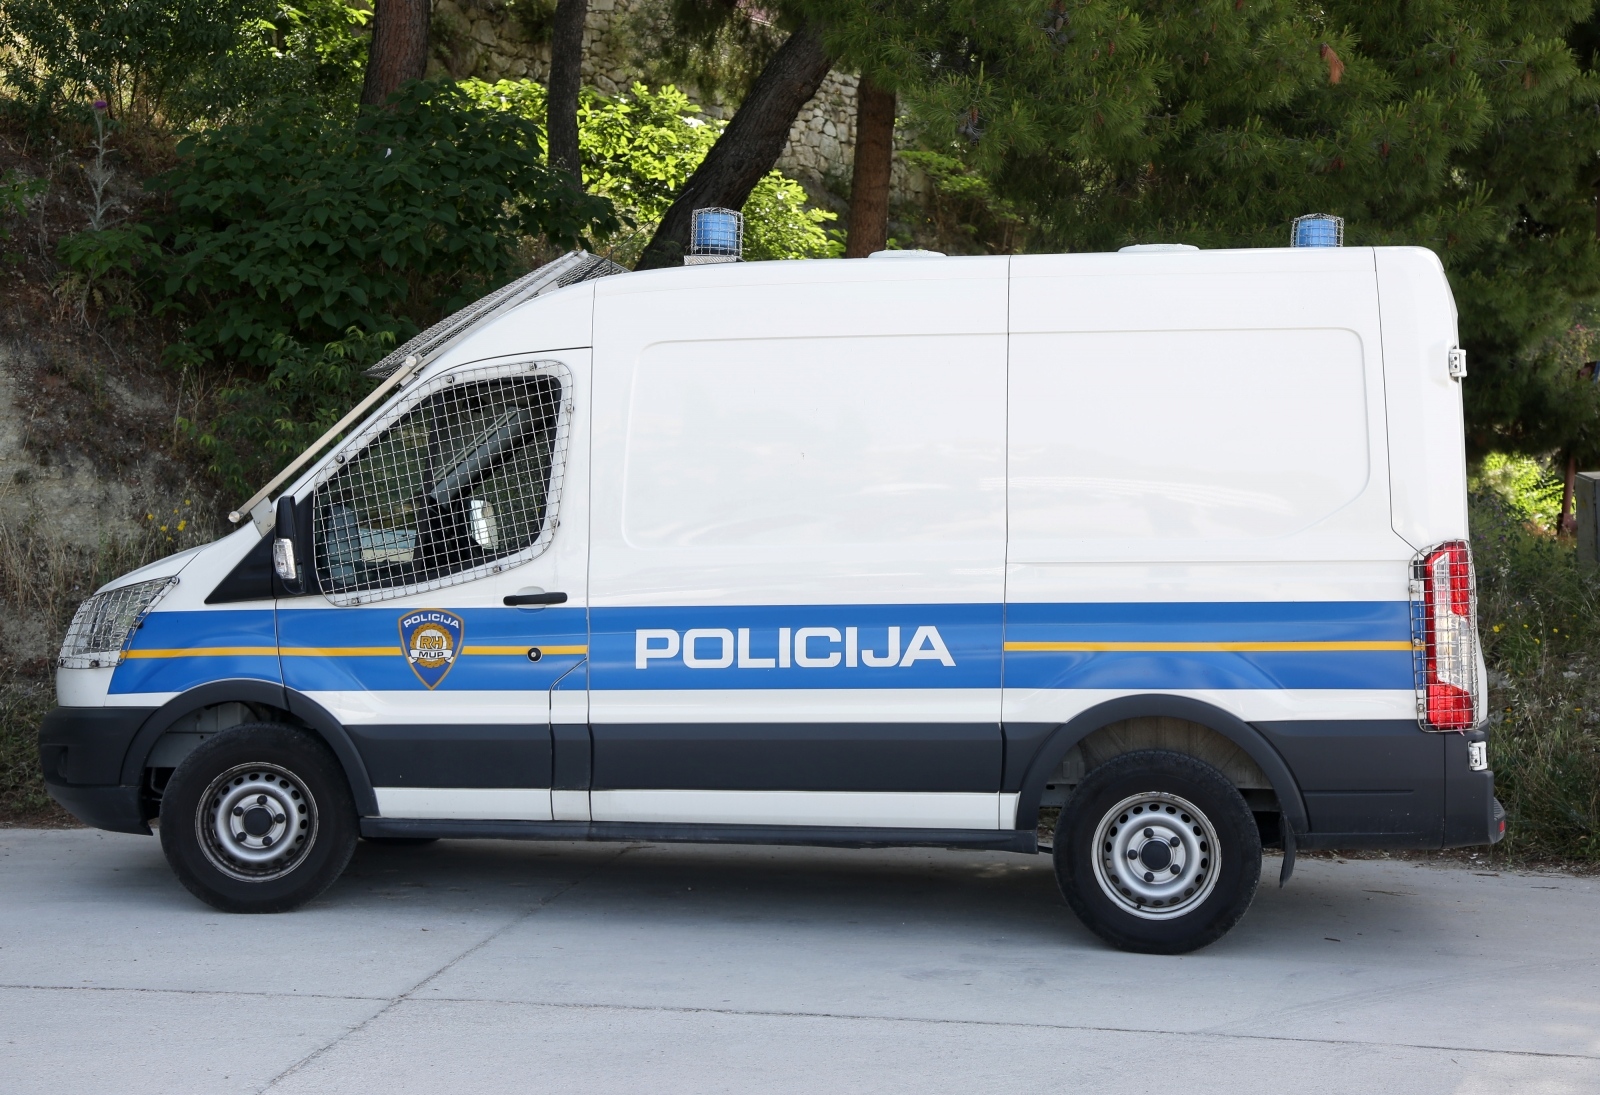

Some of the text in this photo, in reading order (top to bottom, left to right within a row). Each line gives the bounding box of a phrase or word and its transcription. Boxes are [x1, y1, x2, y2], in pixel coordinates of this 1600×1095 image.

[403, 613, 459, 628] POLICIJA
[420, 635, 443, 649] RH
[635, 626, 957, 669] POLICIJA
